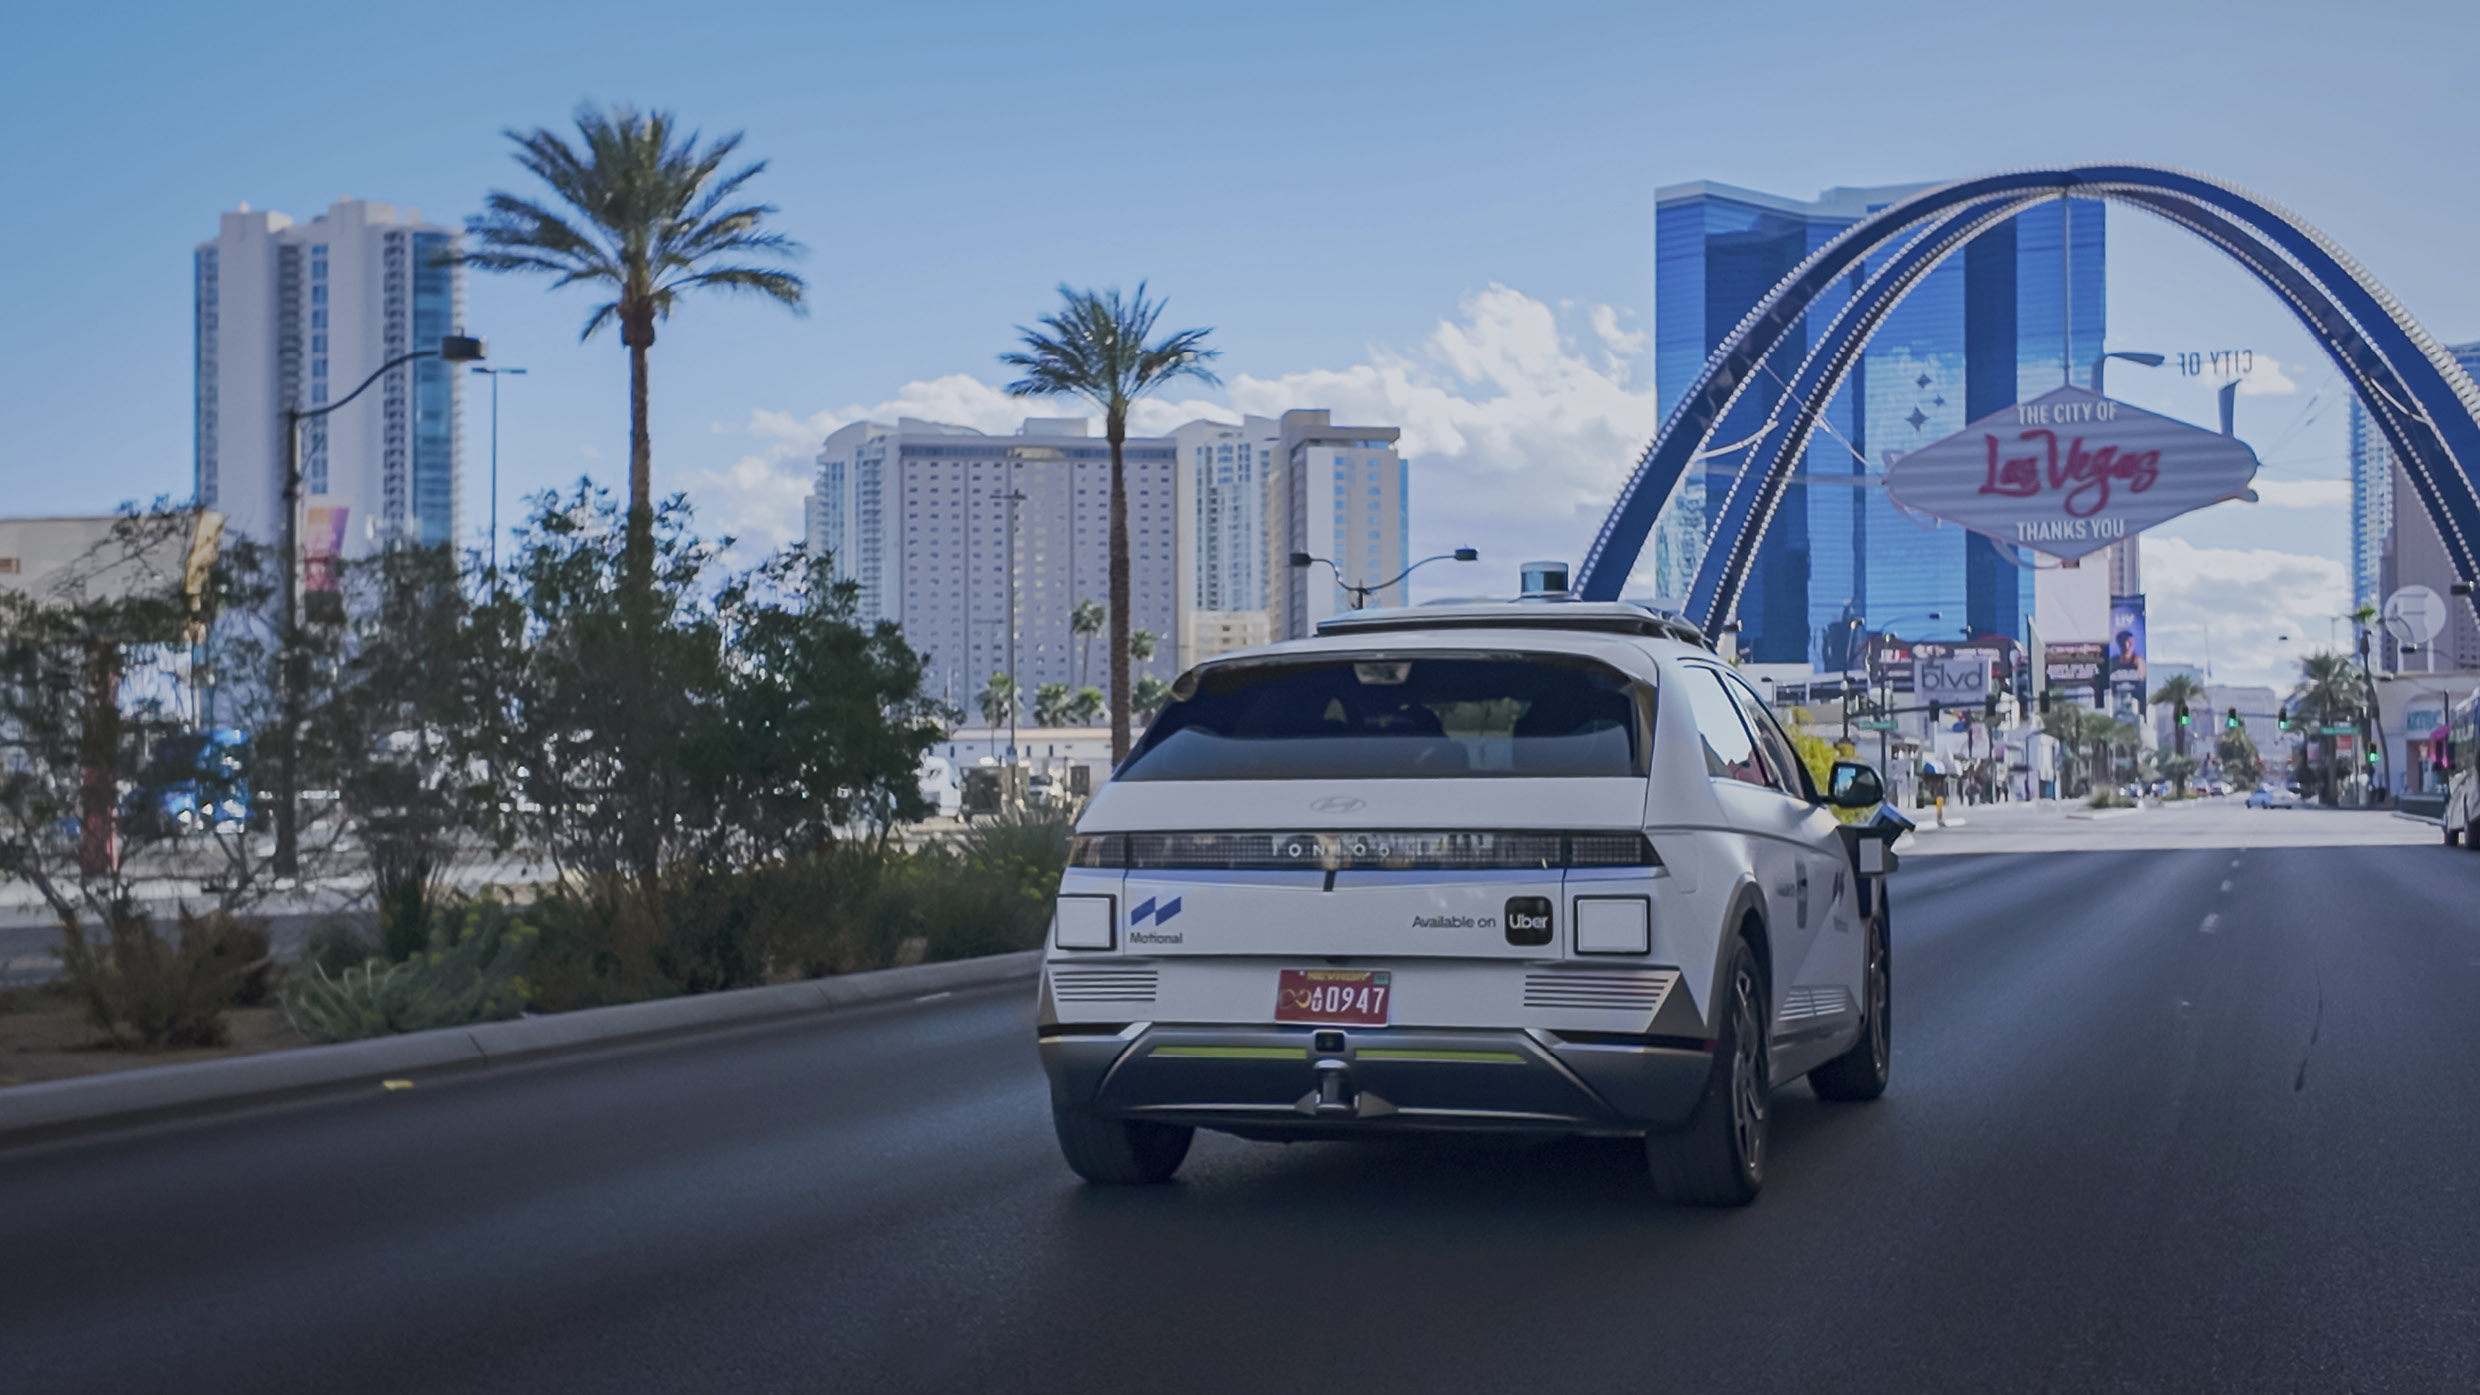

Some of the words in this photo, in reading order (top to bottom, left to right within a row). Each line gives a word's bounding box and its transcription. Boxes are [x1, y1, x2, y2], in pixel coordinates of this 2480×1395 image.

[2018, 403, 2049, 425] THE
[2053, 402, 2092, 424] CITY
[2096, 401, 2118, 422] OF
[1977, 433, 2042, 498] Las
[2018, 428, 2162, 518] Vegas
[2016, 519, 2087, 542] THANKS
[2091, 518, 2125, 539] YOU
[1921, 662, 1983, 690] blvd
[1412, 914, 1475, 929] Available
[1477, 917, 1497, 929] on
[1508, 913, 1549, 930] Uber
[1129, 931, 1183, 945] Motional
